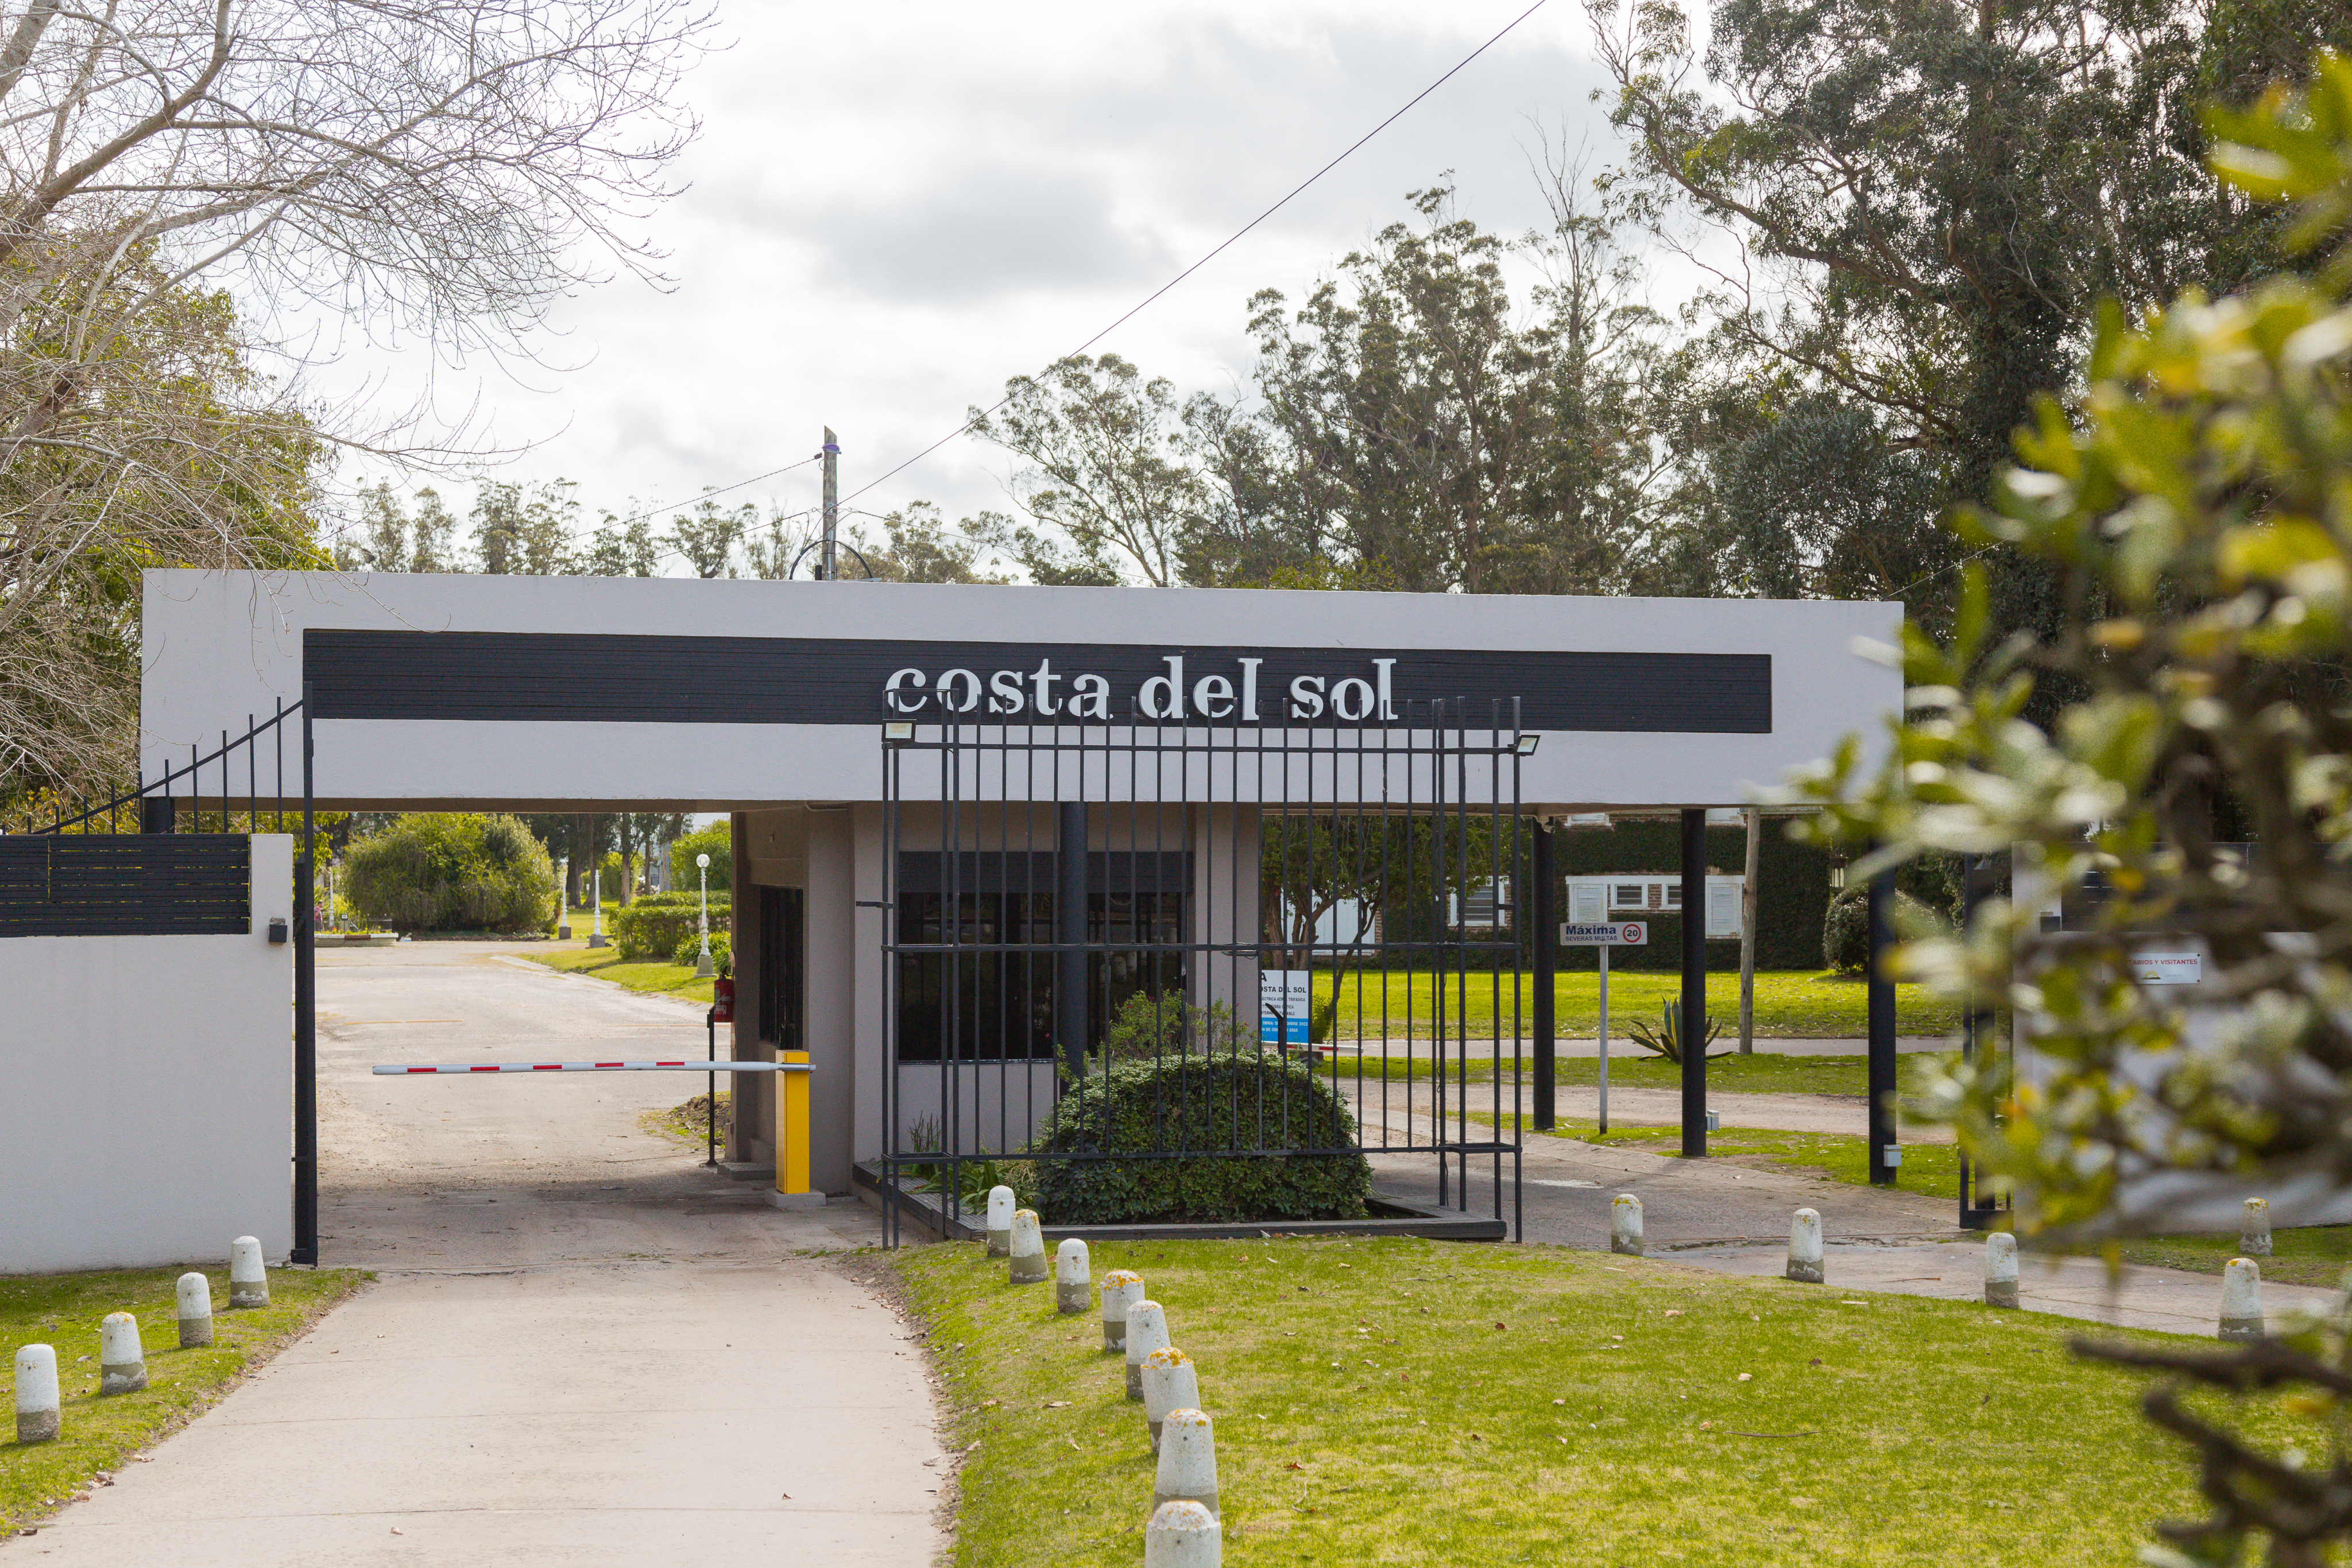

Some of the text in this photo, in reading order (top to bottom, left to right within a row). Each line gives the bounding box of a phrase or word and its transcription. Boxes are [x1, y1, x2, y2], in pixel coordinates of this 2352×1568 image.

[885, 656, 1398, 721] costa del sol
[1566, 925, 1616, 935] Máxima
[1627, 929, 1638, 937] 20
